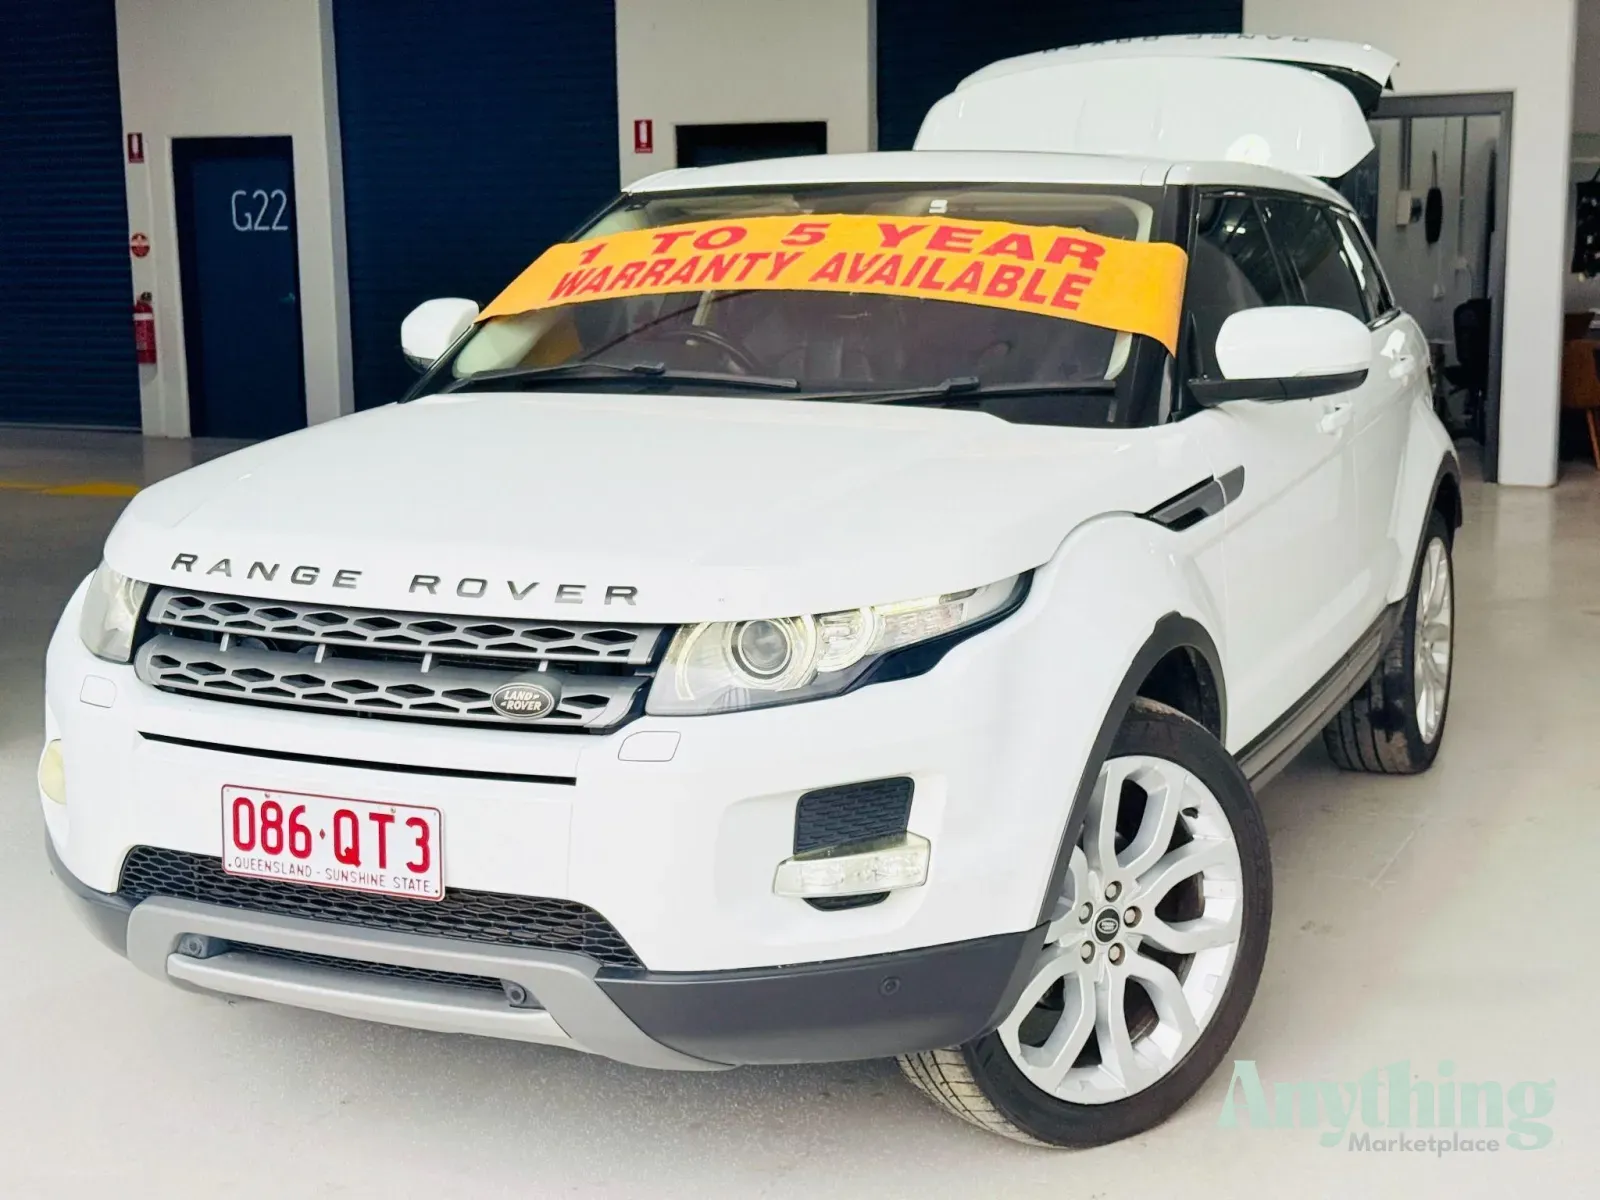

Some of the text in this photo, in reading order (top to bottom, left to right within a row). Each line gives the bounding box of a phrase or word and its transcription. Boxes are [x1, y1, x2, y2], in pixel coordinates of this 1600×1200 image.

[231, 189, 288, 231] G22
[579, 223, 1106, 271] 1 TO 5 YEAR
[547, 252, 1092, 311] WARRANTY AVAILABLE
[170, 553, 639, 606] RANGE ROVER
[503, 690, 534, 700] LAND
[506, 701, 542, 711] ROVER
[234, 857, 312, 877] QUEENSLAND
[325, 868, 385, 887] SUNSHINE
[393, 878, 431, 893] STATE
